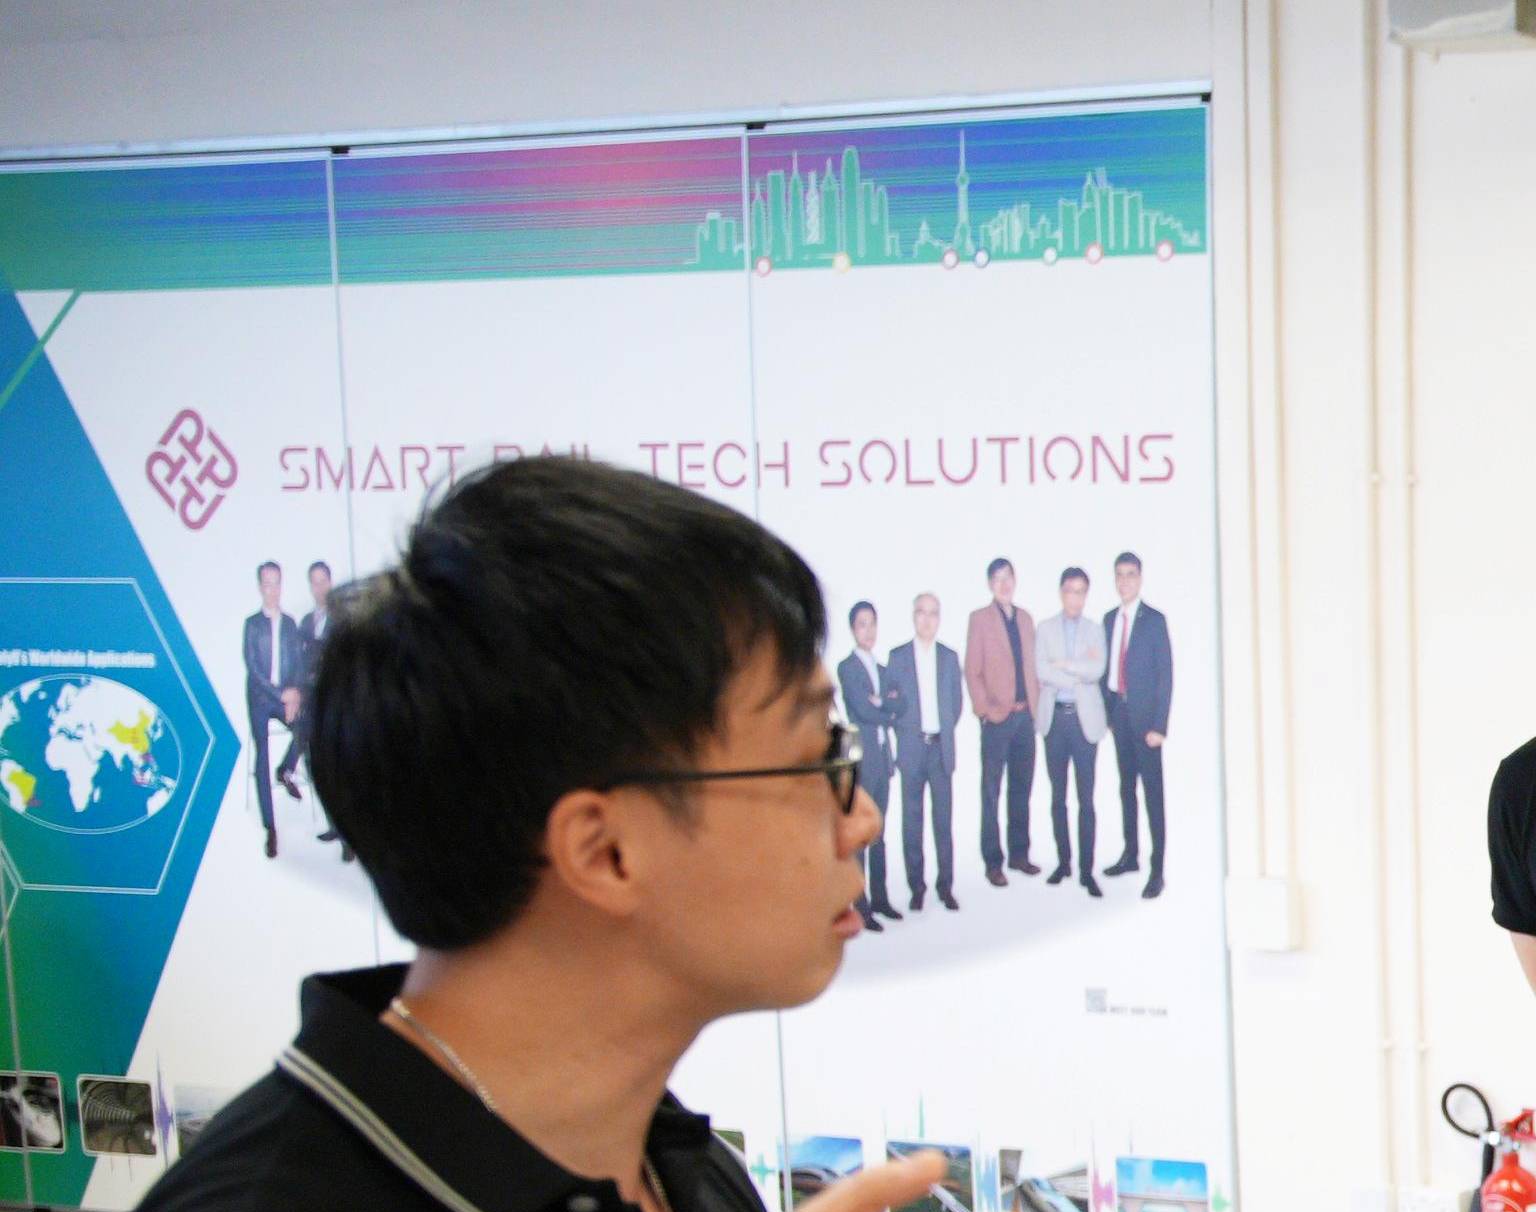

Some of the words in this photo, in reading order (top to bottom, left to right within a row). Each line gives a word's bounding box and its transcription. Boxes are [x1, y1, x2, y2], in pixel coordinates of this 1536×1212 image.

[278, 444, 466, 492] SMART
[638, 440, 790, 488] TECH
[819, 434, 1175, 487] SOLUTIONS
